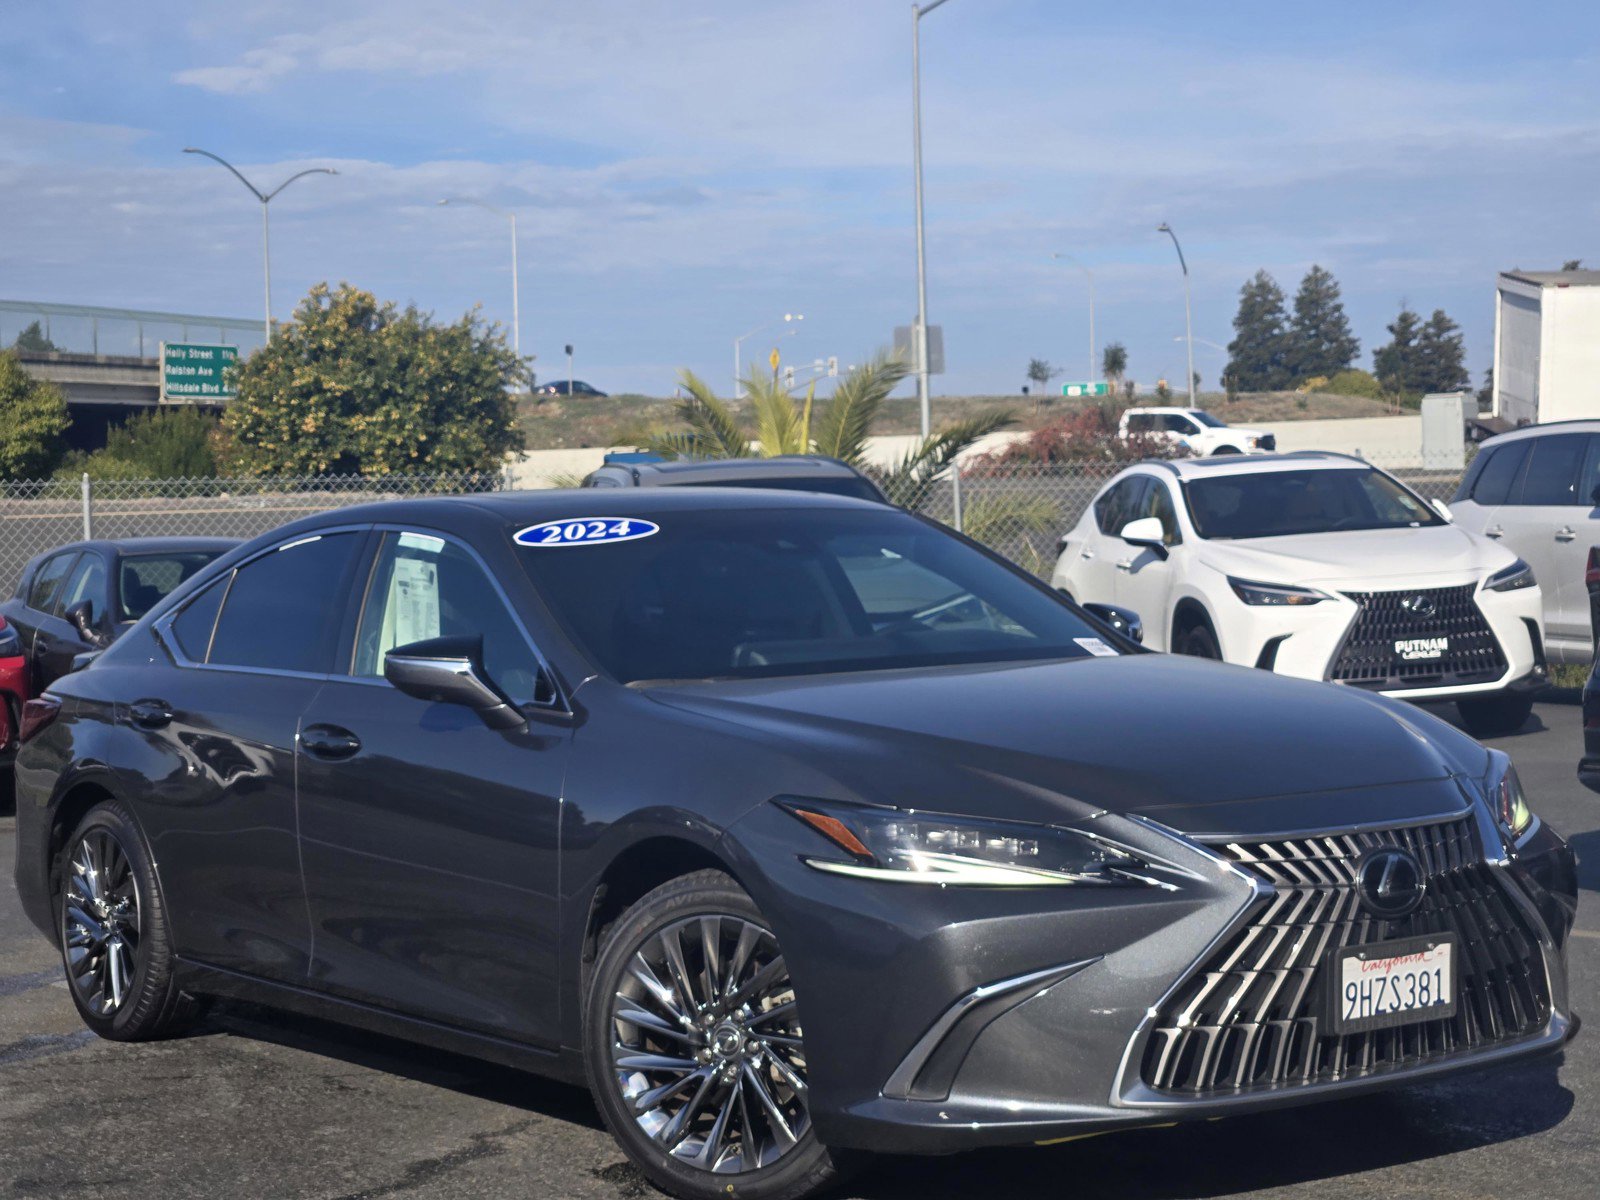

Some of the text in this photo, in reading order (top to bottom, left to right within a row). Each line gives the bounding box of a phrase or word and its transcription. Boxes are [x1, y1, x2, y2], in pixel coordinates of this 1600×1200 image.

[189, 348, 213, 359] Street
[166, 364, 196, 375] Ralston
[198, 366, 213, 376] Ave
[166, 382, 200, 393] Hillsdale
[202, 382, 219, 393] Blvd
[541, 520, 631, 543] 2024
[1395, 637, 1448, 653] PUTNAM
[1343, 968, 1445, 1021] 9HZS381
